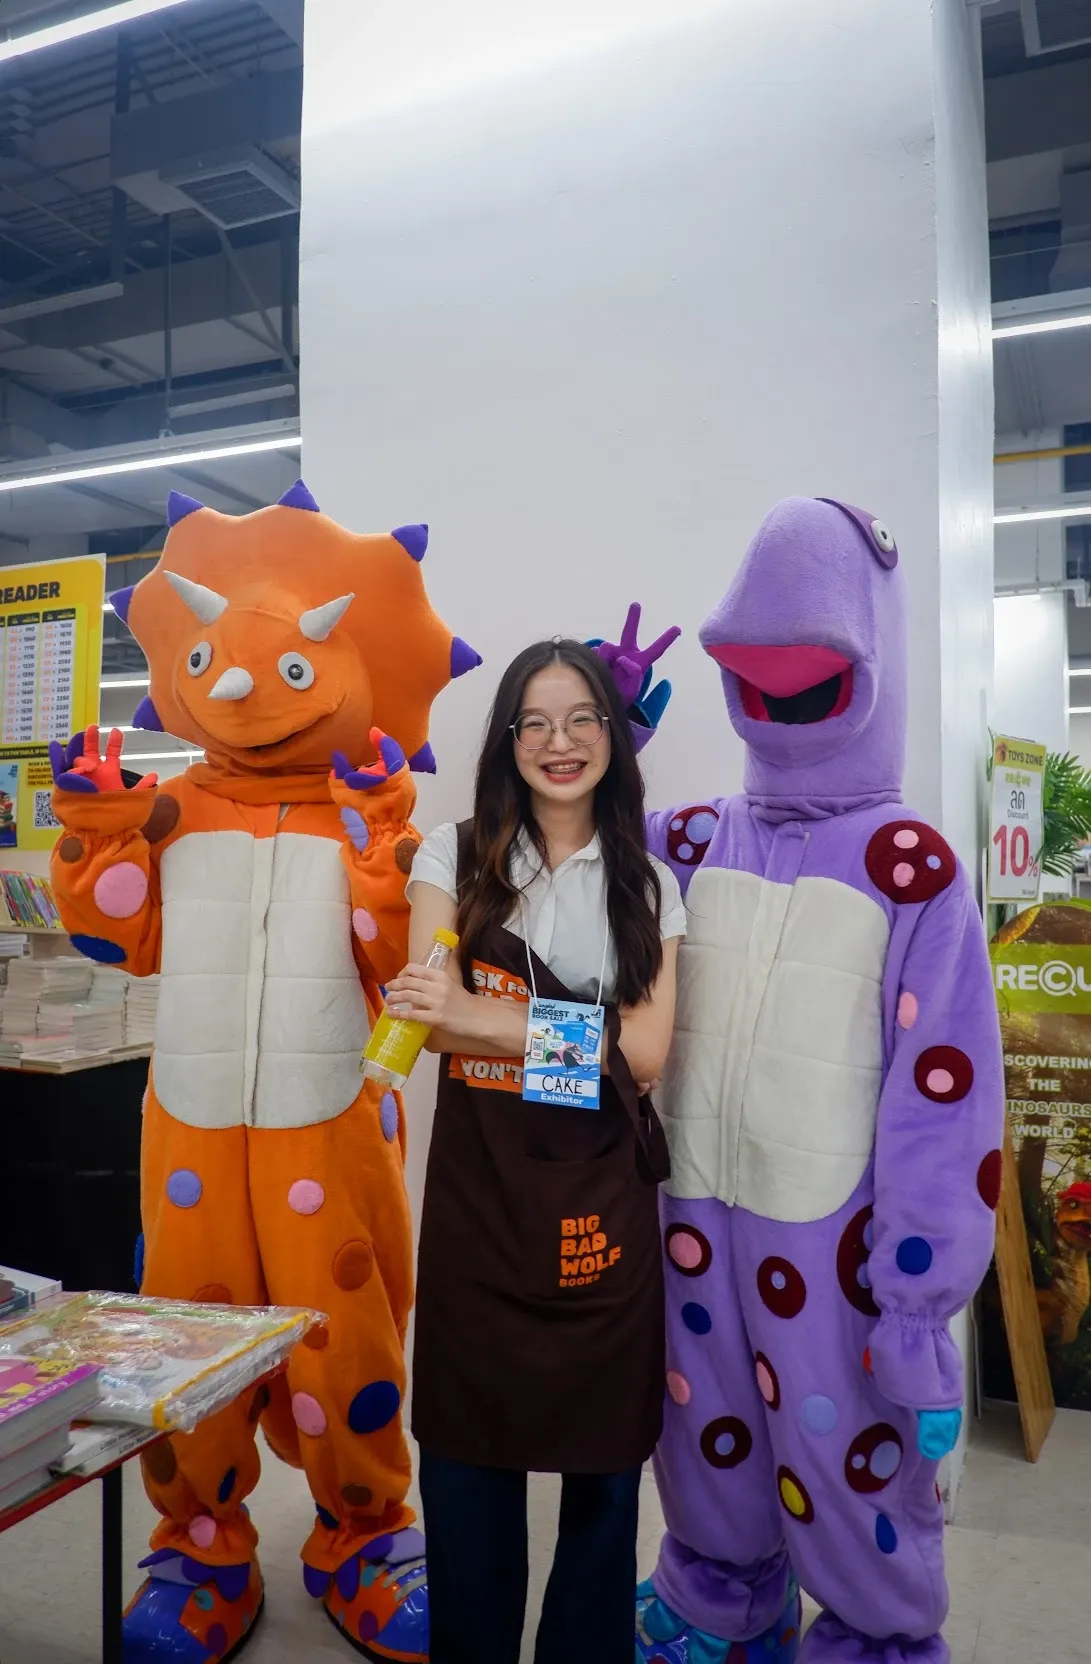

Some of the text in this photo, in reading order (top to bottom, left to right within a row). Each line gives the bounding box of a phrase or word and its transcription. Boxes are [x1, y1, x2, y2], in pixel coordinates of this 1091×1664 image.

[0, 581, 61, 605] EADER
[1008, 750, 1043, 766] TOYS ZONE
[1010, 790, 1025, 810] ลด
[1007, 810, 1029, 819] Discount
[993, 824, 1038, 877] 10%
[472, 968, 504, 992] SK
[532, 1008, 569, 1018] BIGGEST
[1004, 1054, 1091, 1070] SCOVERIN
[542, 1074, 583, 1095] CAKE
[1028, 1078, 1061, 1092] THE
[540, 1093, 584, 1105] Exhibitor
[1014, 1124, 1074, 1139] WORLD
[561, 1214, 600, 1236] BIG
[561, 1232, 607, 1256] BAD
[560, 1246, 621, 1276] WOLF
[559, 1274, 600, 1287] BOOKS
